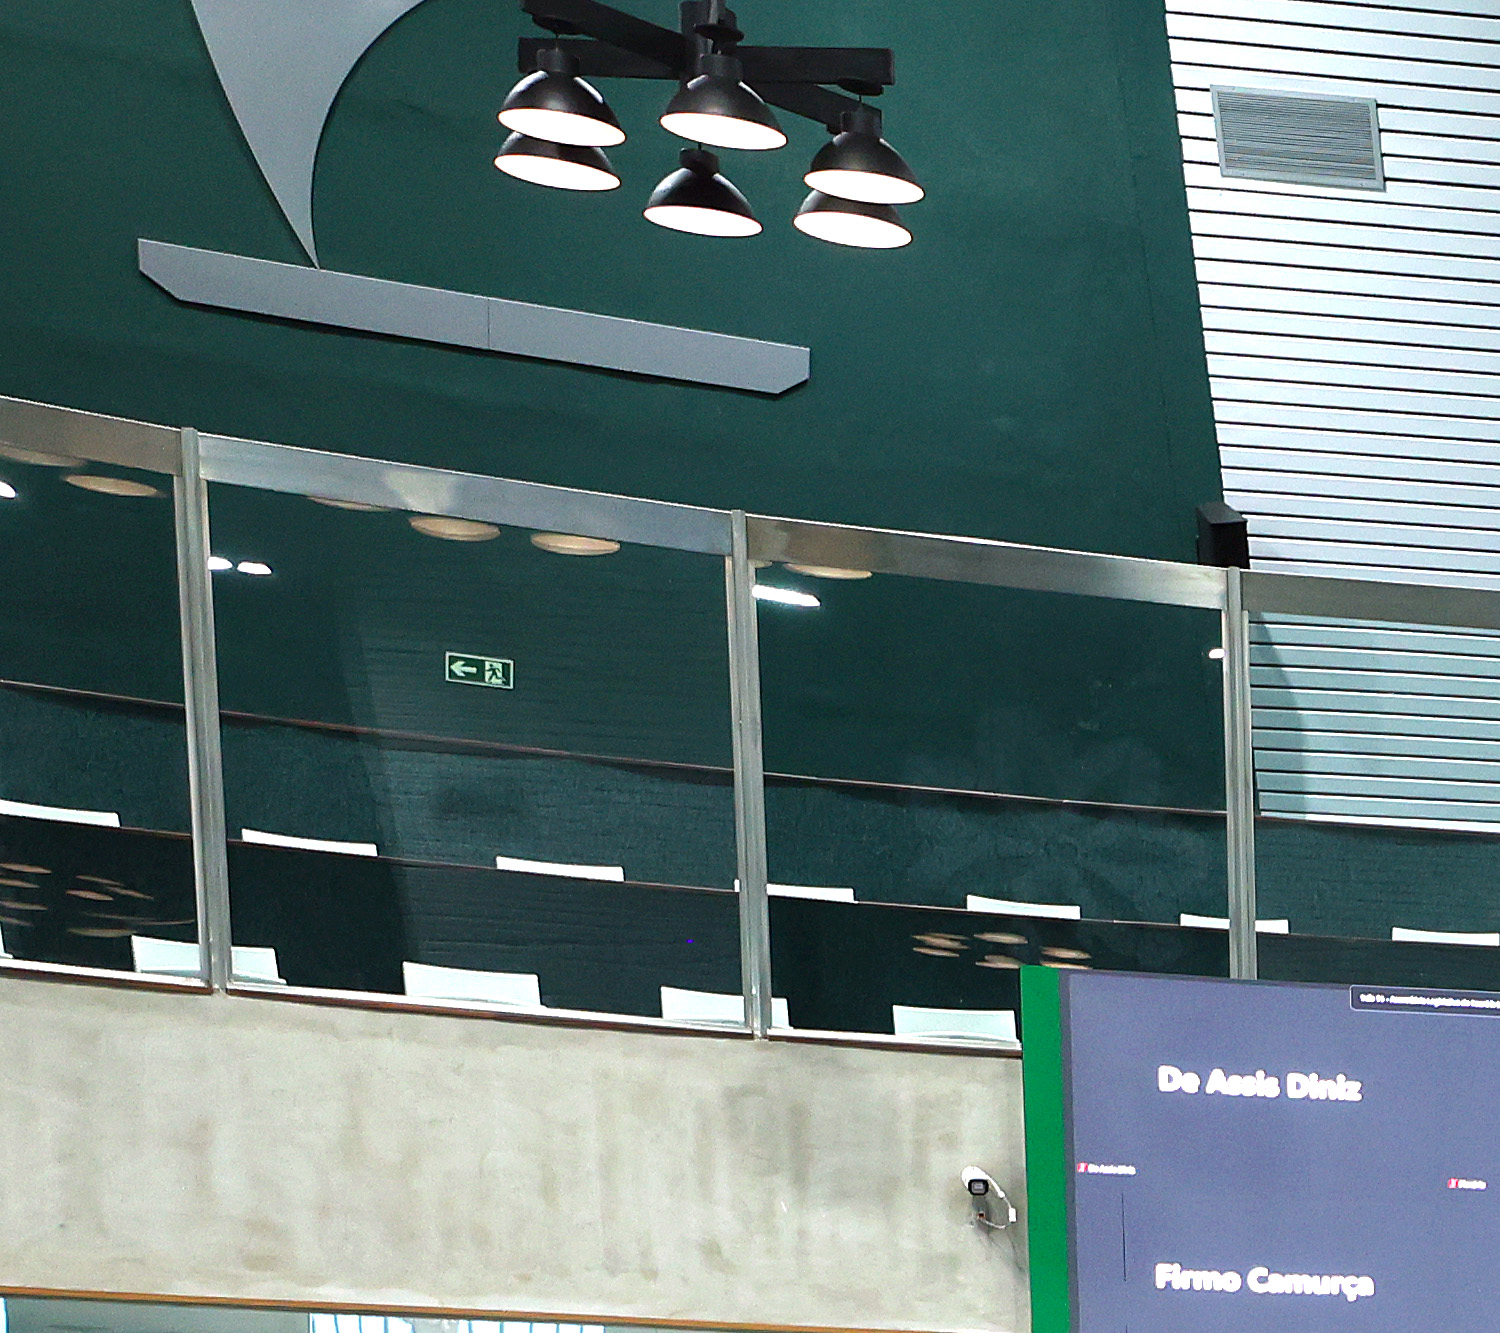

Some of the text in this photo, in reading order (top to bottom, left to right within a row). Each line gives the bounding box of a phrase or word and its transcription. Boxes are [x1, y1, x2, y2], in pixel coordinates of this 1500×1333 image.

[1158, 1065, 1362, 1101] De Assis Diniz
[1156, 1263, 1374, 1301] Firmo Camurça
